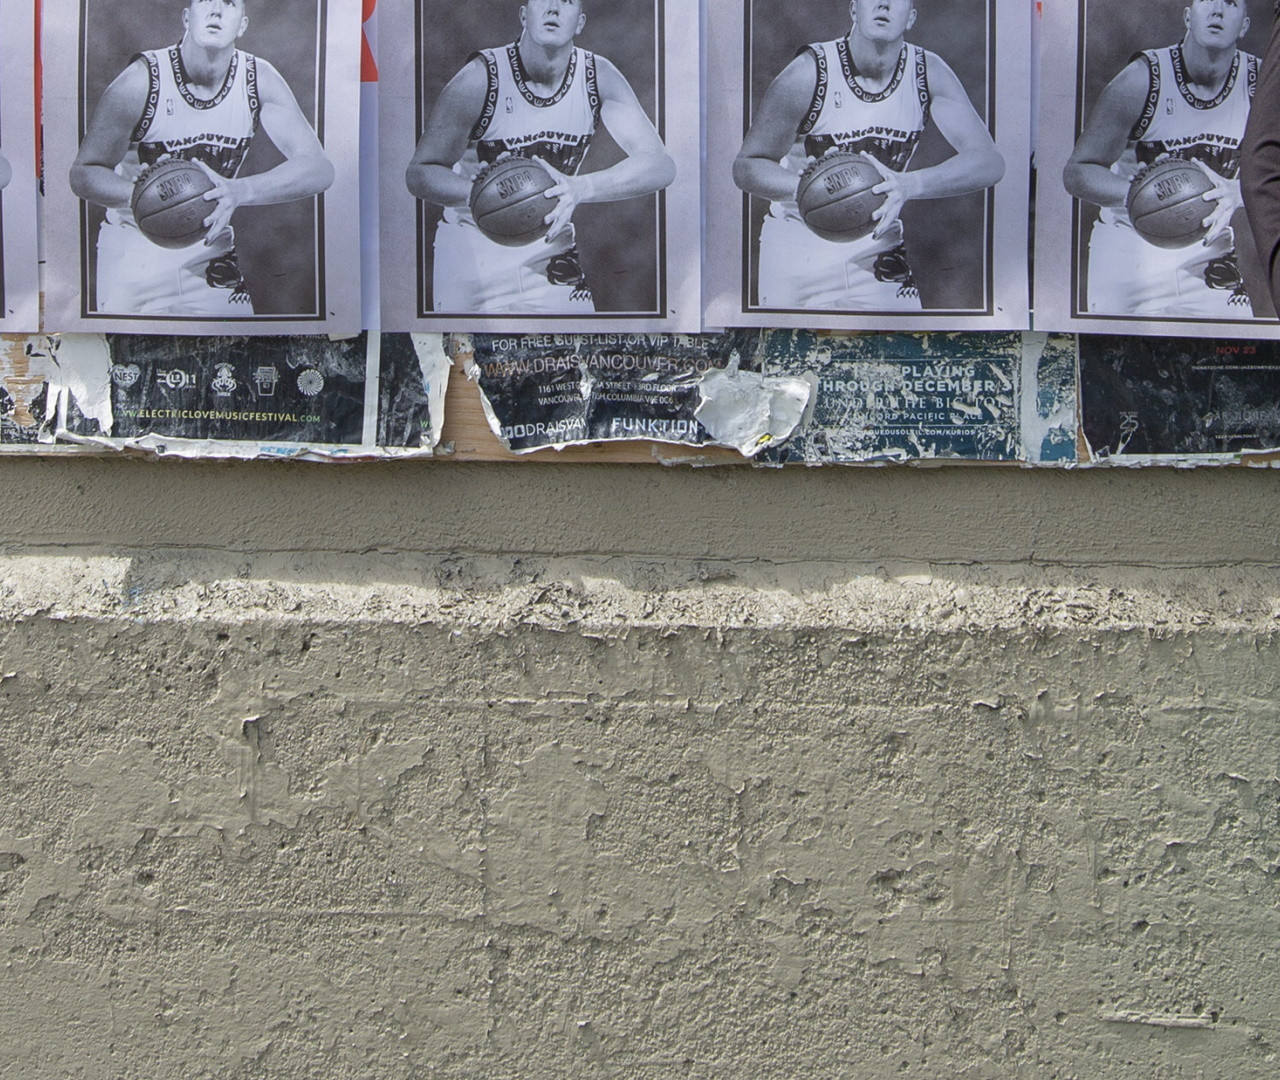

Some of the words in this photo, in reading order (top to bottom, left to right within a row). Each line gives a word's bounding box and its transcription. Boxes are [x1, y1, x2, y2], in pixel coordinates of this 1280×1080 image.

[506, 131, 578, 146] VANCOUVER
[834, 126, 908, 141] VANCOUVER
[166, 133, 238, 148] VANCOUVER
[1165, 133, 1239, 148] VANCOUVER
[492, 339, 518, 352] FOR
[521, 335, 552, 350] FREE
[649, 335, 669, 347] VIP
[1216, 346, 1240, 354] NOV
[1243, 346, 1257, 354] 23
[902, 365, 976, 378] PLAYING
[556, 381, 575, 392] WEST
[902, 380, 995, 392] DECEMBER
[825, 397, 885, 409] UNDR
[903, 412, 946, 420] PACIFIC
